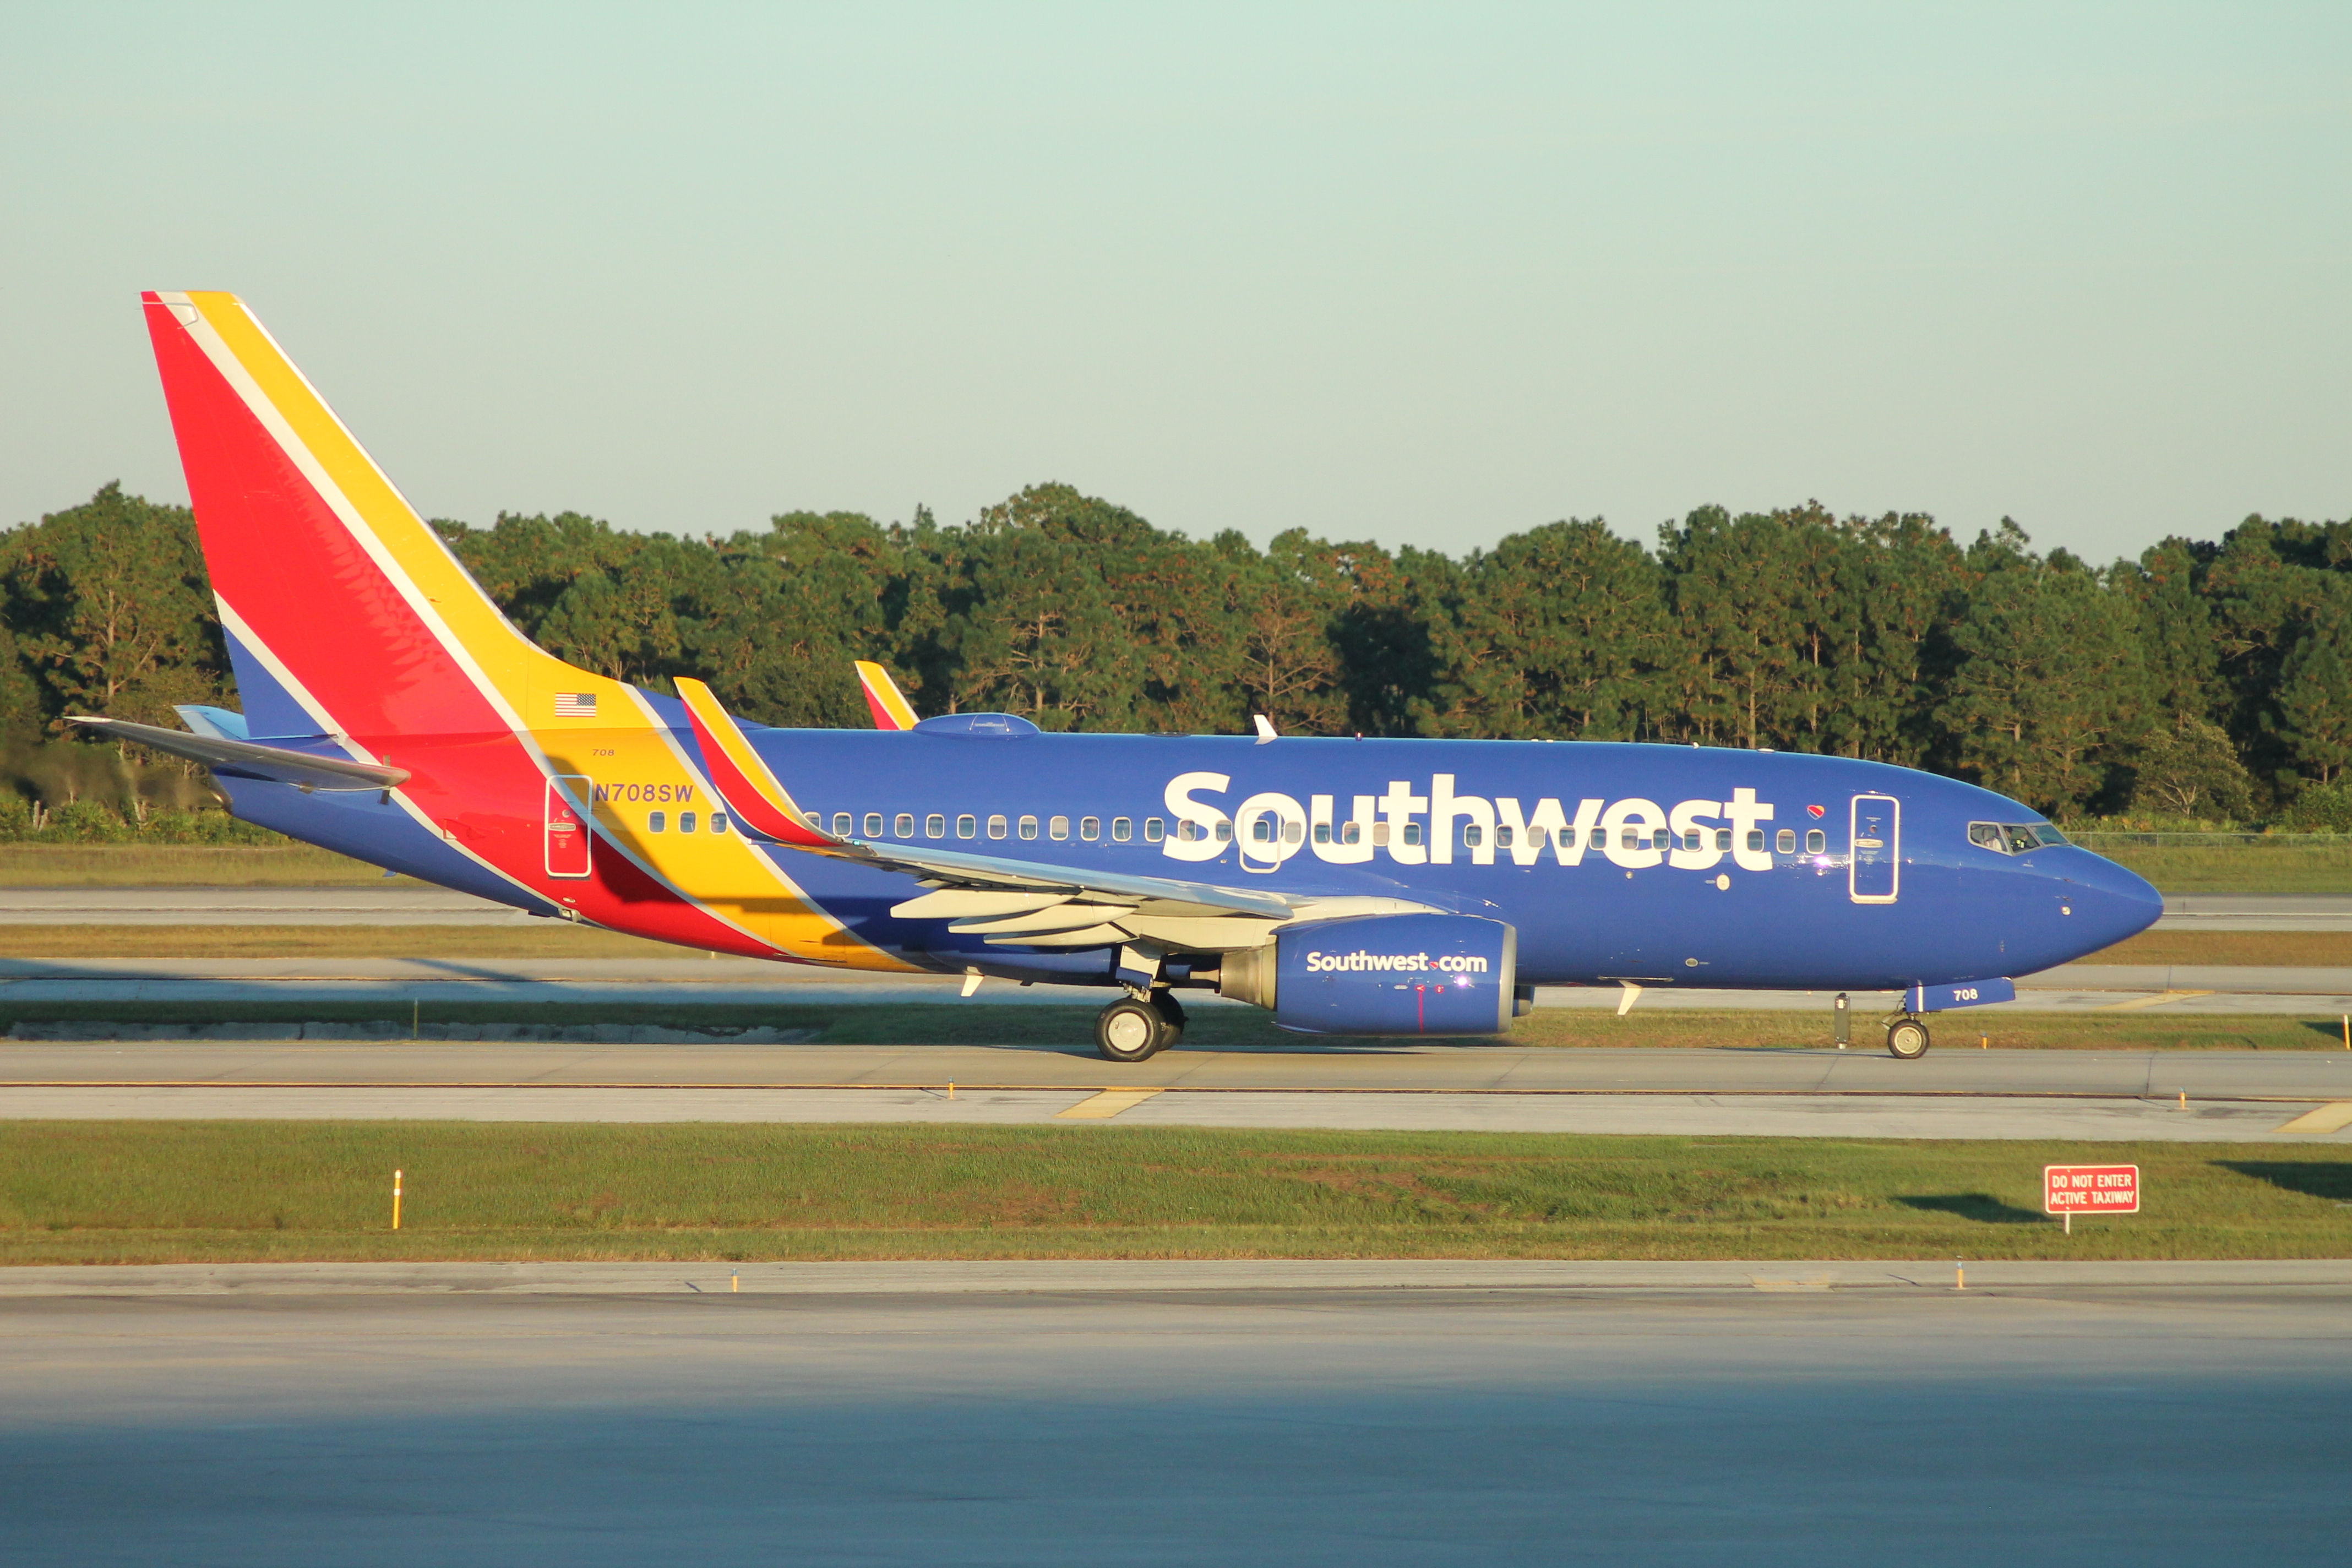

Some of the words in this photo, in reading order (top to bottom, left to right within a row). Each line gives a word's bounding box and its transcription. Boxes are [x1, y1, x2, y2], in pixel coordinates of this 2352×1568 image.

[595, 783, 693, 802] N708SW
[1162, 772, 1774, 871] Southwest
[1953, 988, 1978, 1001] 708
[2052, 1175, 2068, 1188] DO
[2072, 1174, 2094, 1188] NOT
[2097, 1174, 2132, 1187] ENTER
[2050, 1191, 2087, 1205] ACTIVE
[2091, 1191, 2135, 1204] TAXIWAY
